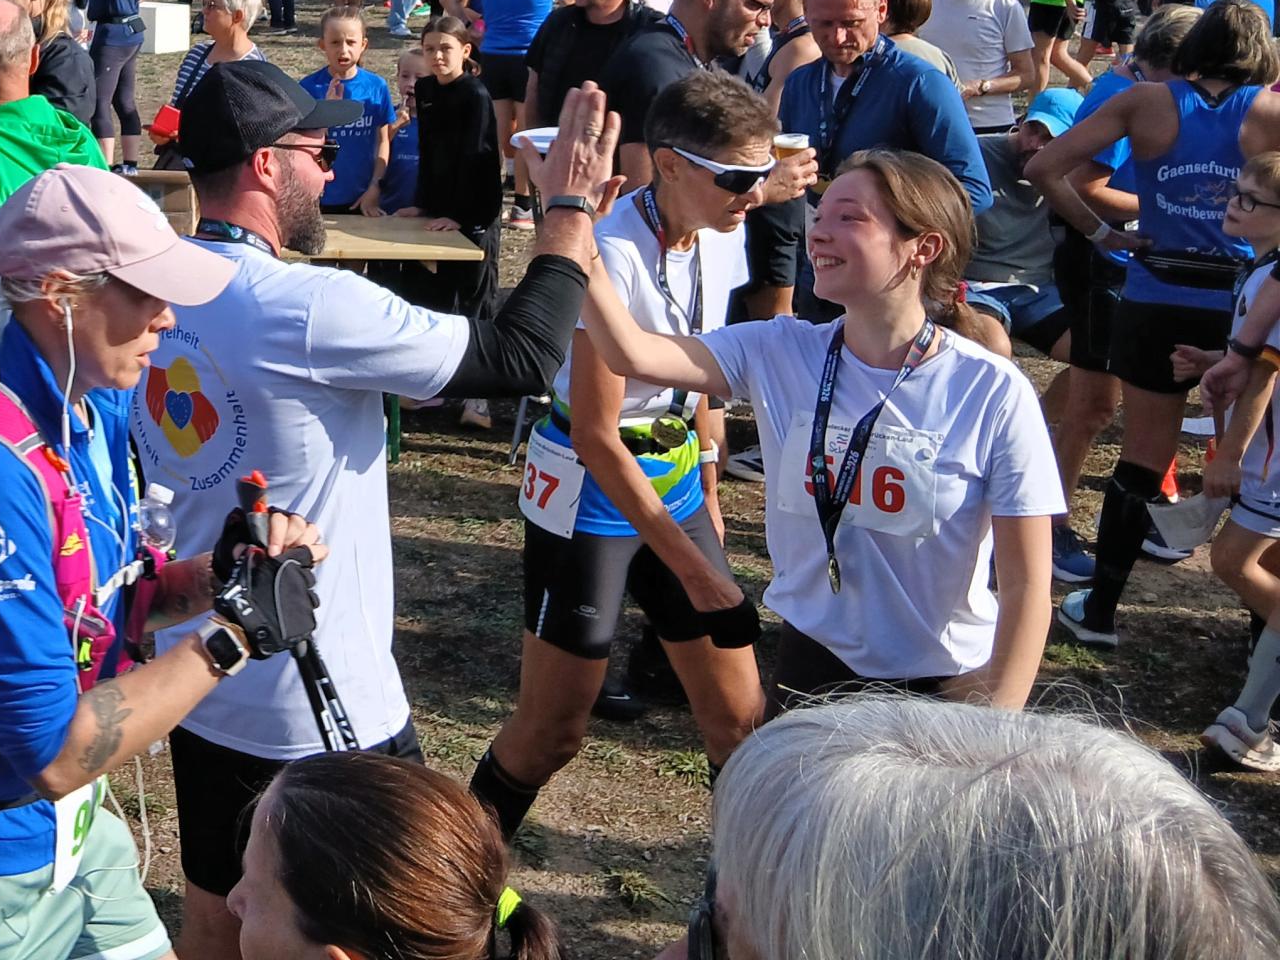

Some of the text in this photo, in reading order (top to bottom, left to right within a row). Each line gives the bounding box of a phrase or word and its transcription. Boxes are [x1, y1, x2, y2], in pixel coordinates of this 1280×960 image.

[1157, 160, 1240, 182] Gaensefurt
[1156, 192, 1224, 221] Sportbewe
[131, 385, 160, 468] eichheit
[189, 389, 248, 491] Zusammenhalt
[524, 461, 561, 510] 37
